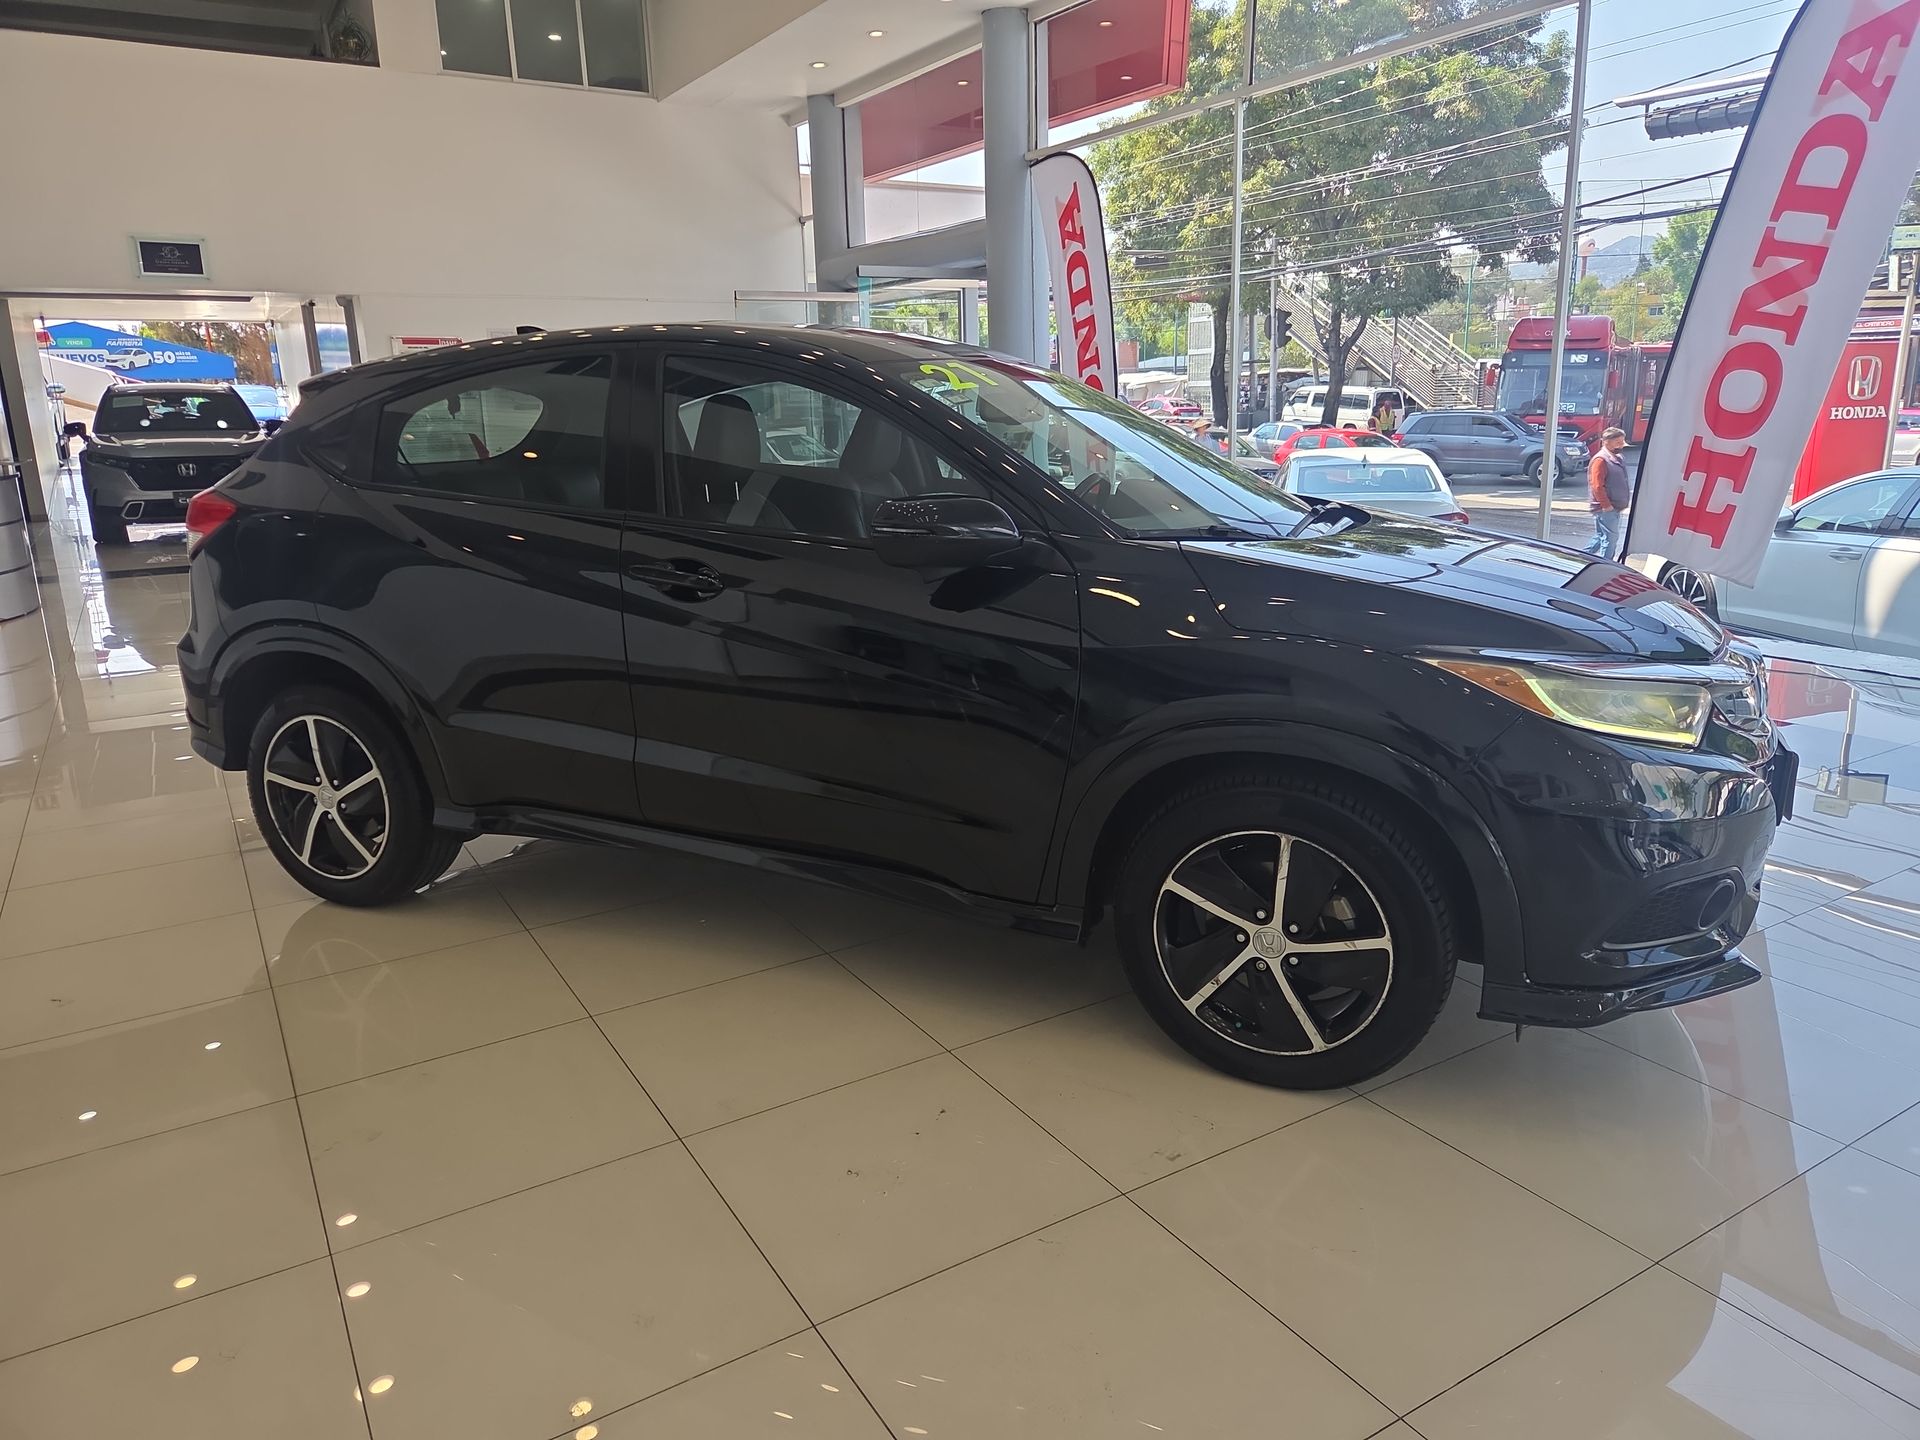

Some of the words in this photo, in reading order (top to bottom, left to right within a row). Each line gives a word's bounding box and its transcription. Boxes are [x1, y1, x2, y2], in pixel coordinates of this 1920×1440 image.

[1058, 182, 1104, 393] NDA
[1668, 0, 1920, 549] HONDA
[152, 351, 176, 364] 50
[919, 360, 999, 391] 21
[1830, 406, 1887, 420] HONDA
